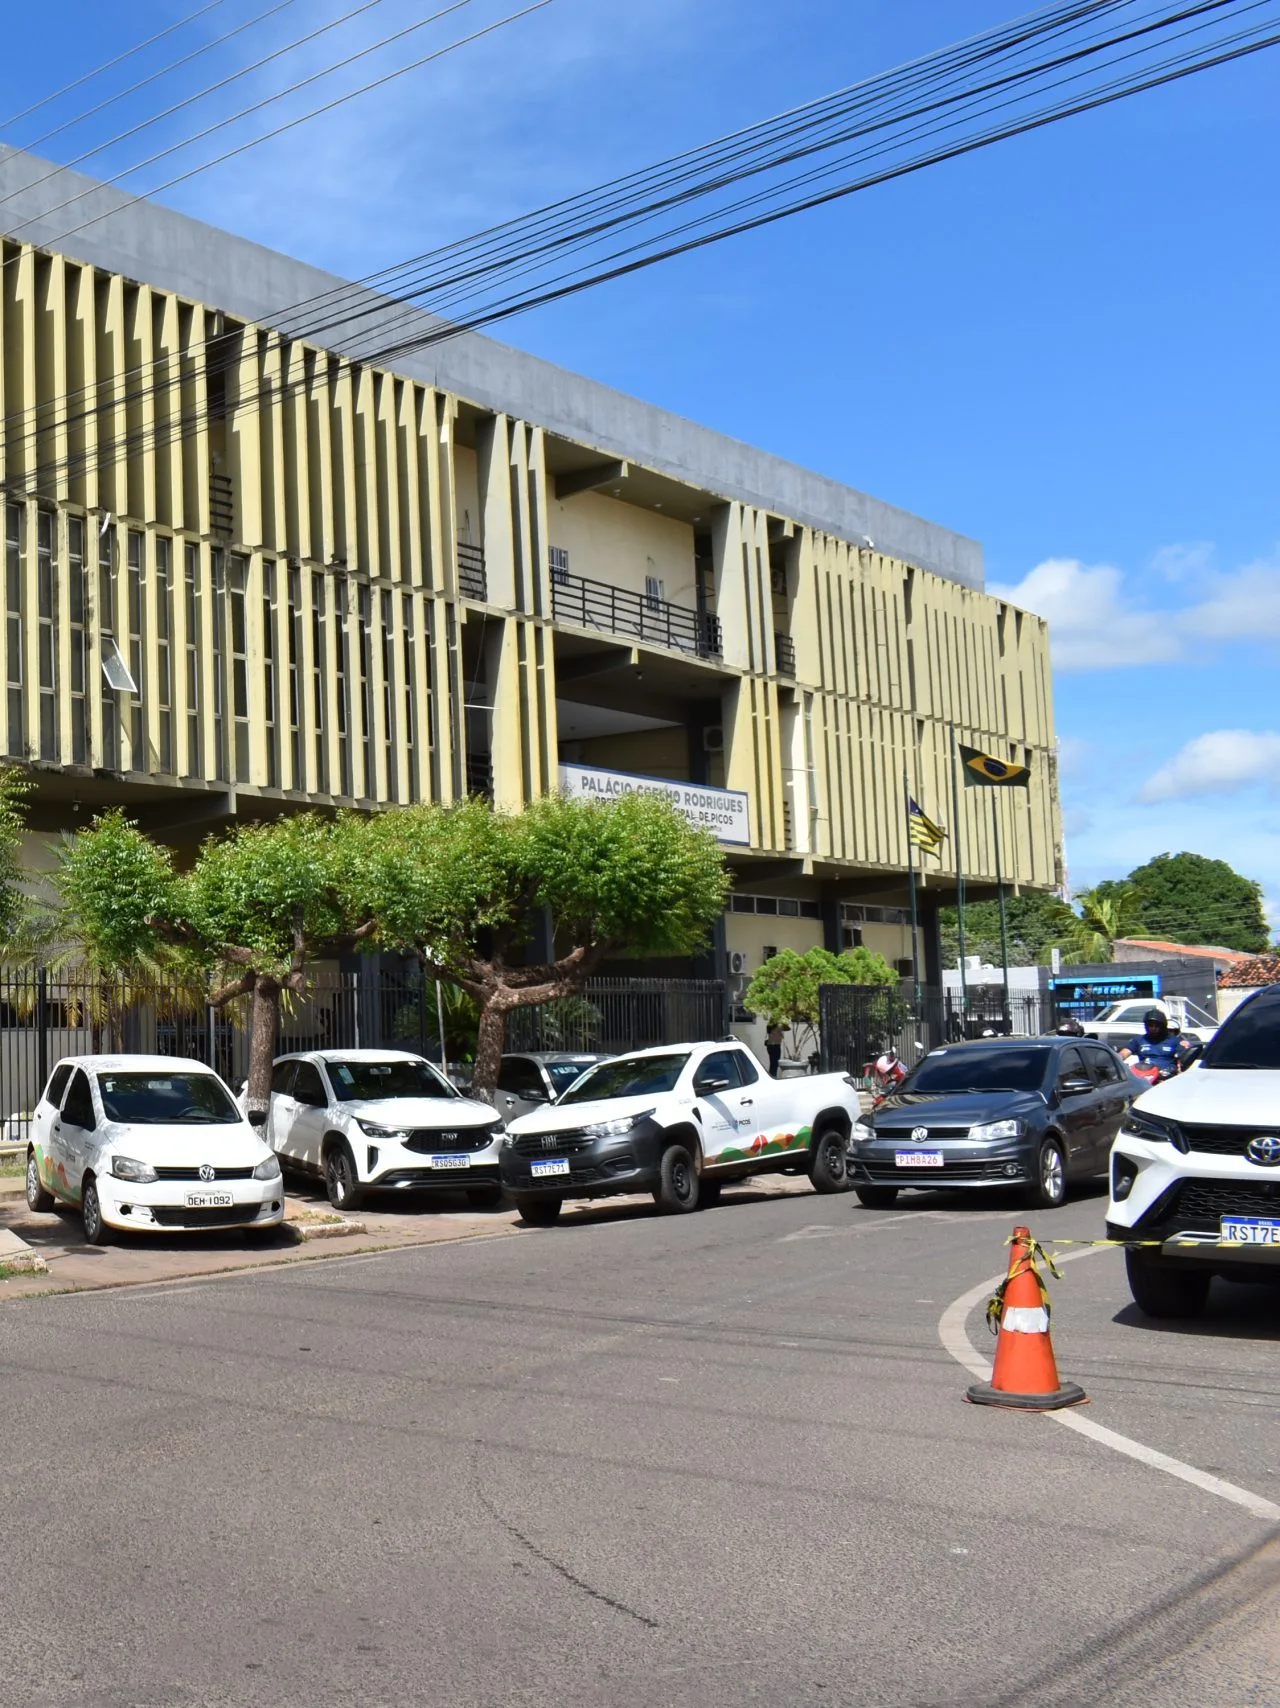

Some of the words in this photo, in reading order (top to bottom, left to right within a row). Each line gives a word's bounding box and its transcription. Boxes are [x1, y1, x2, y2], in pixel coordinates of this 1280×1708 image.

[581, 776, 633, 795] PALÁCIO
[684, 792, 743, 813] RODRIGUES
[698, 811, 710, 822] DE
[711, 813, 734, 825] PICOS
[1228, 1225, 1280, 1243] RST7E
